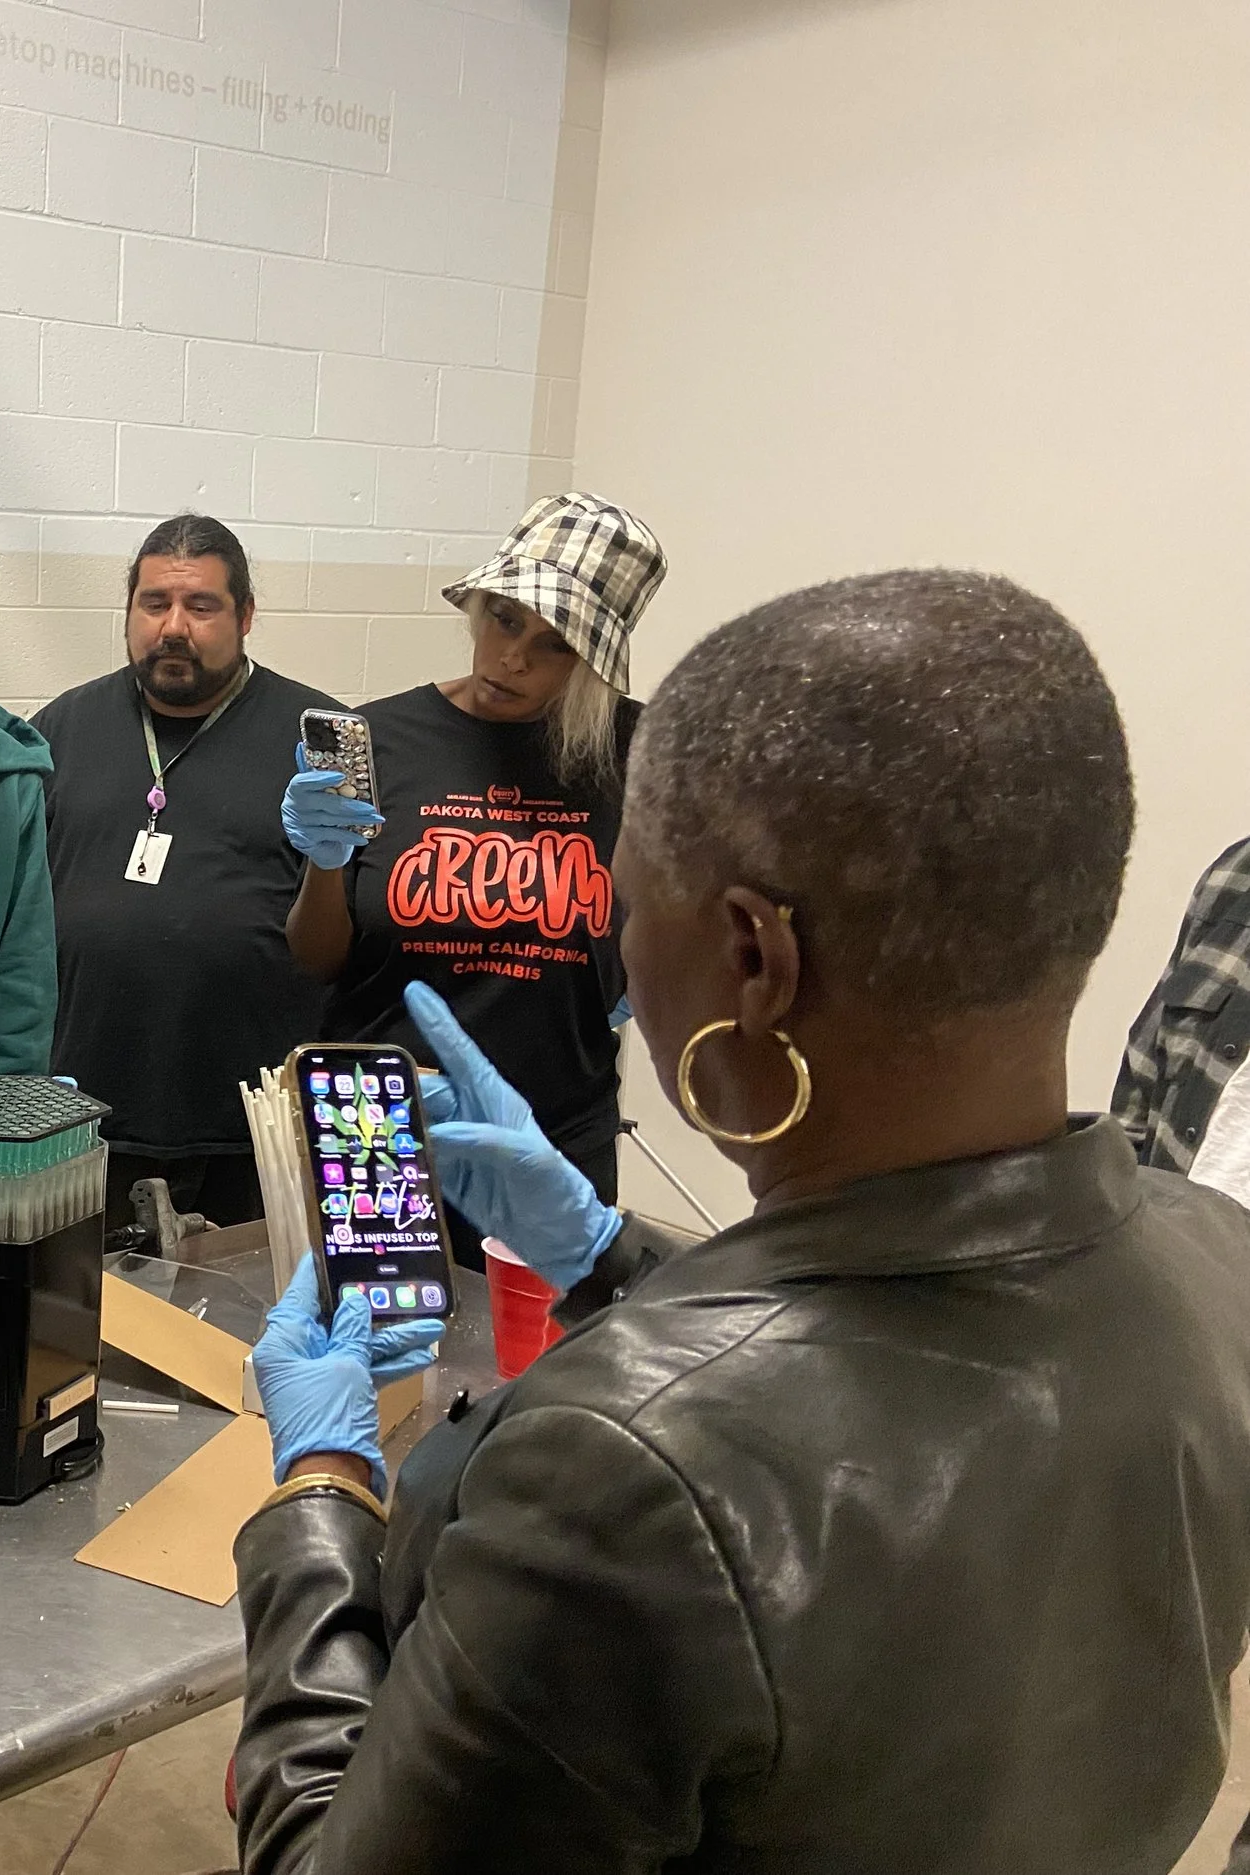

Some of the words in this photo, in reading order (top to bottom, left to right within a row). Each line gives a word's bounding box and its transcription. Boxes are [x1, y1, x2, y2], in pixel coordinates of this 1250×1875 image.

[64, 49, 195, 97] machines
[222, 75, 289, 123] filling
[293, 96, 308, 114] +
[313, 96, 391, 145] folding
[419, 805, 484, 820] DAKOTA
[487, 808, 532, 823] WEST
[536, 810, 591, 824] COAST
[402, 942, 483, 956] PREMIUM
[488, 943, 589, 966] CALIFORNIA
[452, 961, 542, 981] CANNABIS
[363, 1232, 414, 1244] INFUSED
[415, 1232, 439, 1243] TOP
